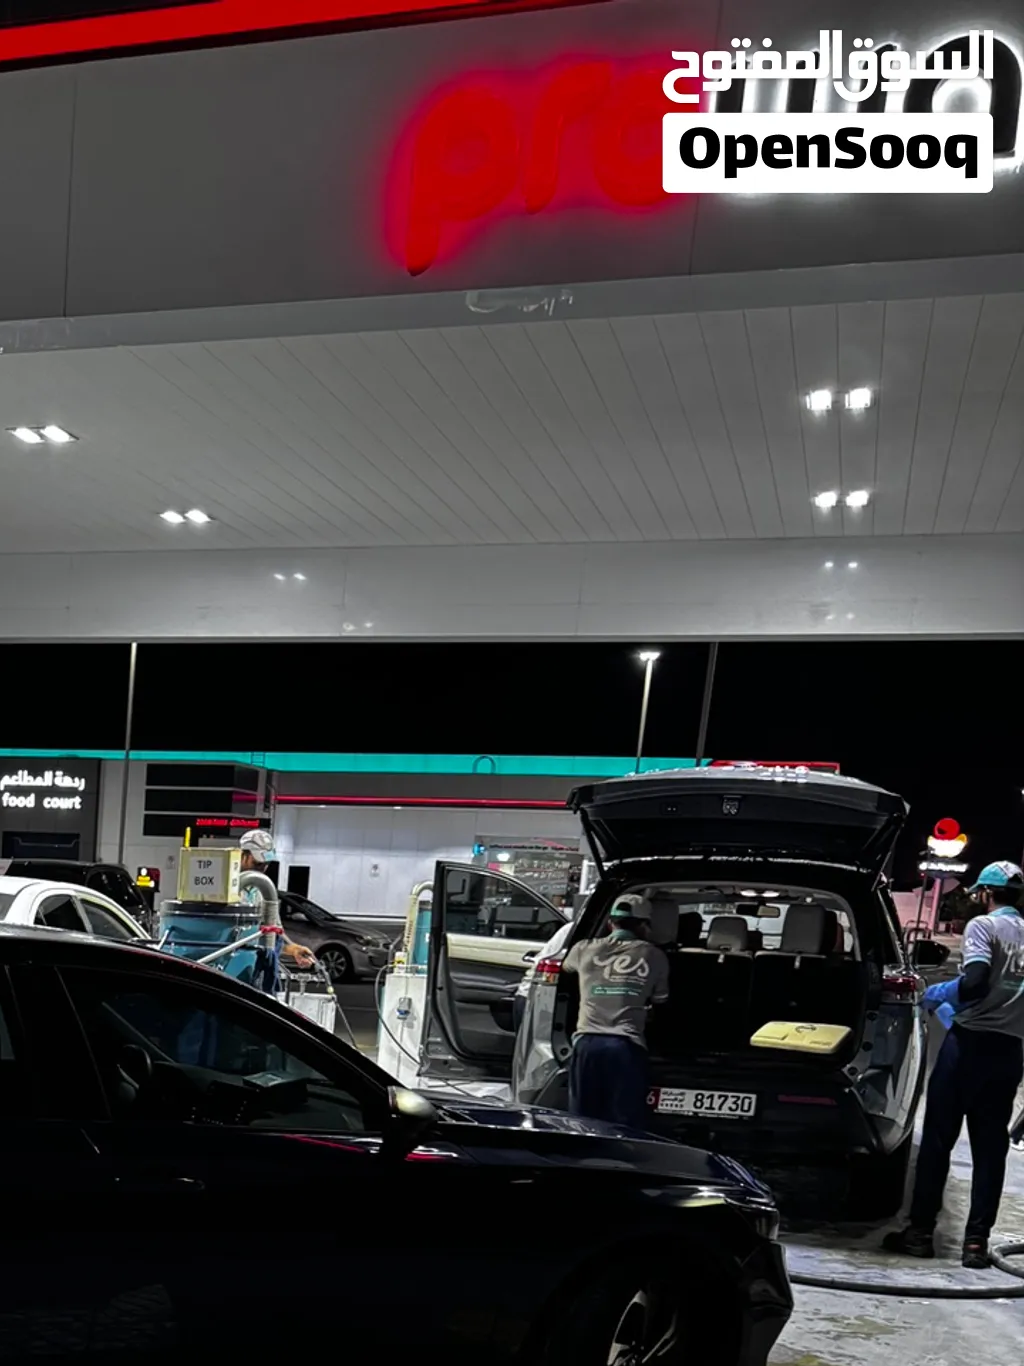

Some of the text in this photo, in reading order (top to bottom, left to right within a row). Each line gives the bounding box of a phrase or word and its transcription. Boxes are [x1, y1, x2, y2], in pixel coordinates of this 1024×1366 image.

[2, 792, 82, 809] food court
[197, 860, 213, 869] TIP
[194, 876, 215, 886] BOX
[593, 955, 650, 980] yes
[693, 1092, 753, 1113] 81730
